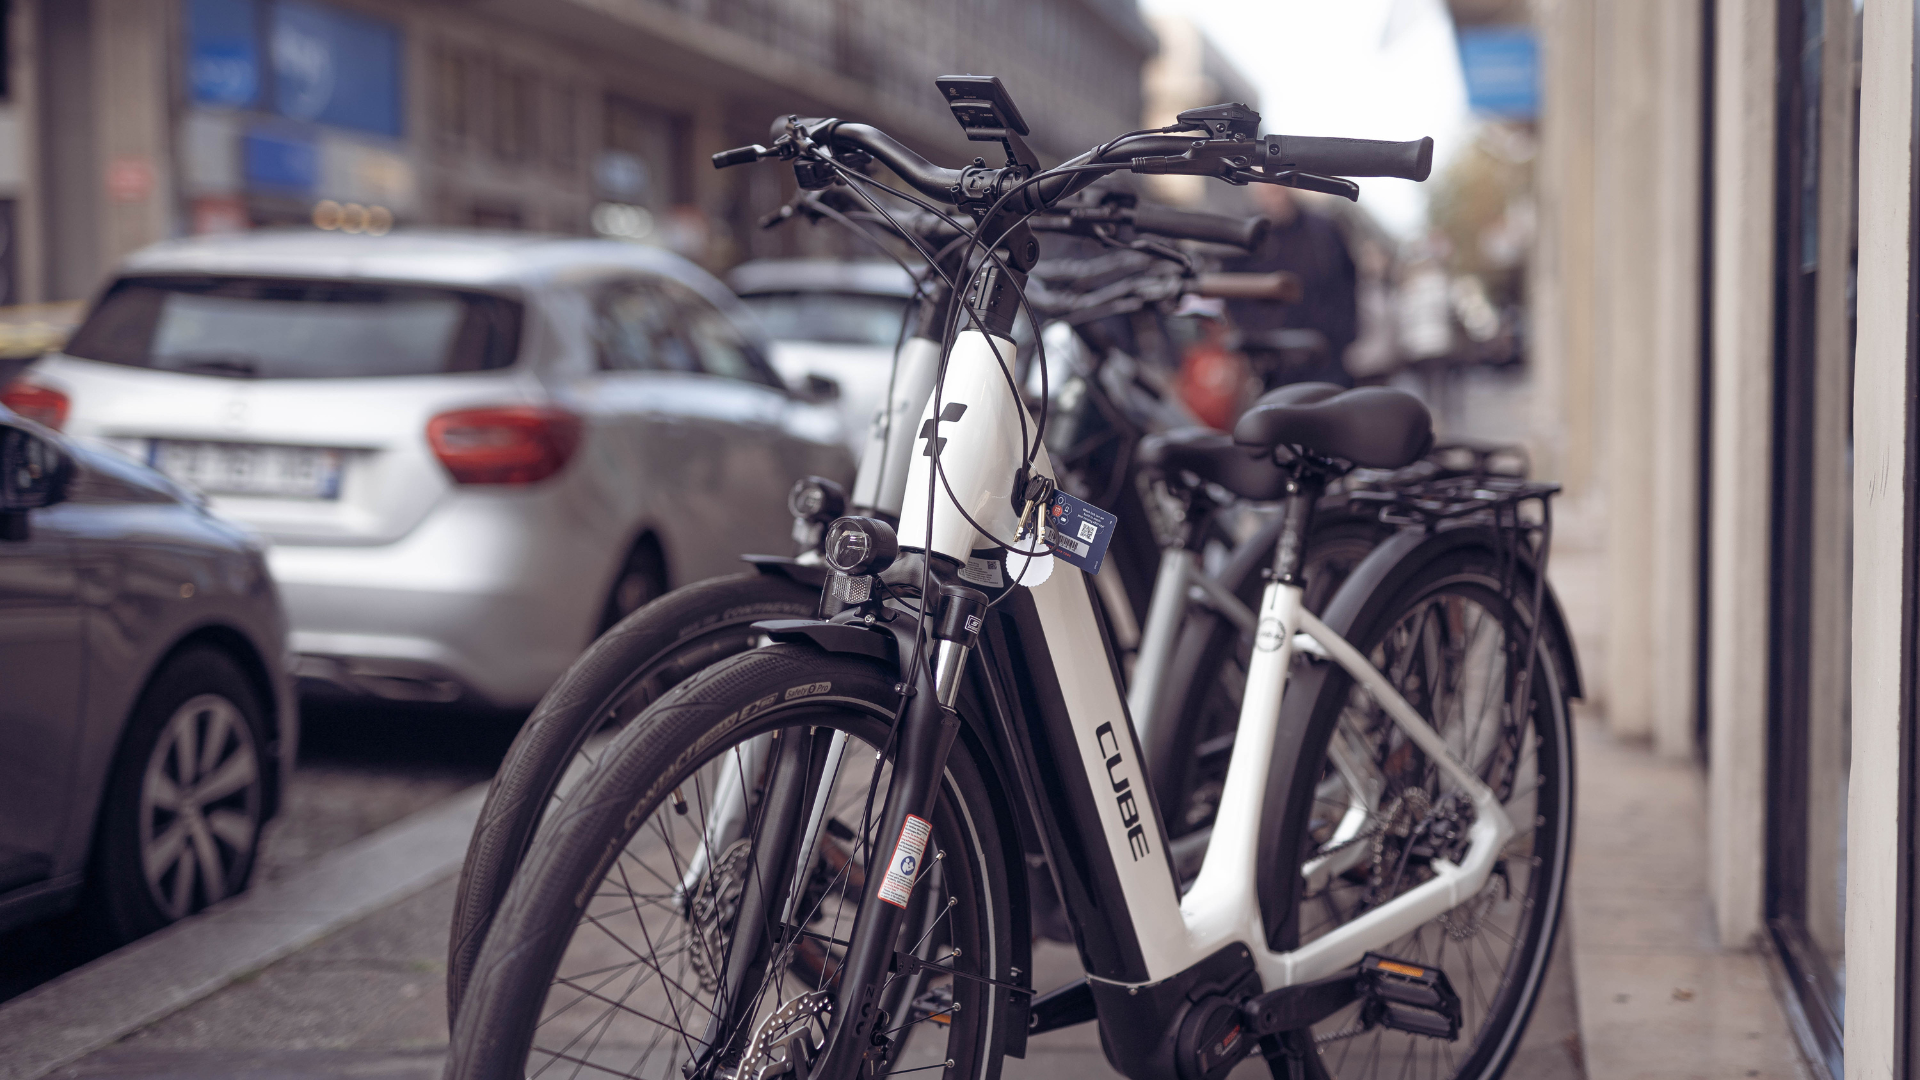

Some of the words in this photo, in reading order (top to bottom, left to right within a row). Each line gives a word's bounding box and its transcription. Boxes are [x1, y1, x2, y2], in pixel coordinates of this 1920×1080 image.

[786, 686, 808, 699] Safety
[816, 683, 830, 693] Pro
[624, 743, 697, 831] CONTACT
[1095, 720, 1150, 862] CUBE
